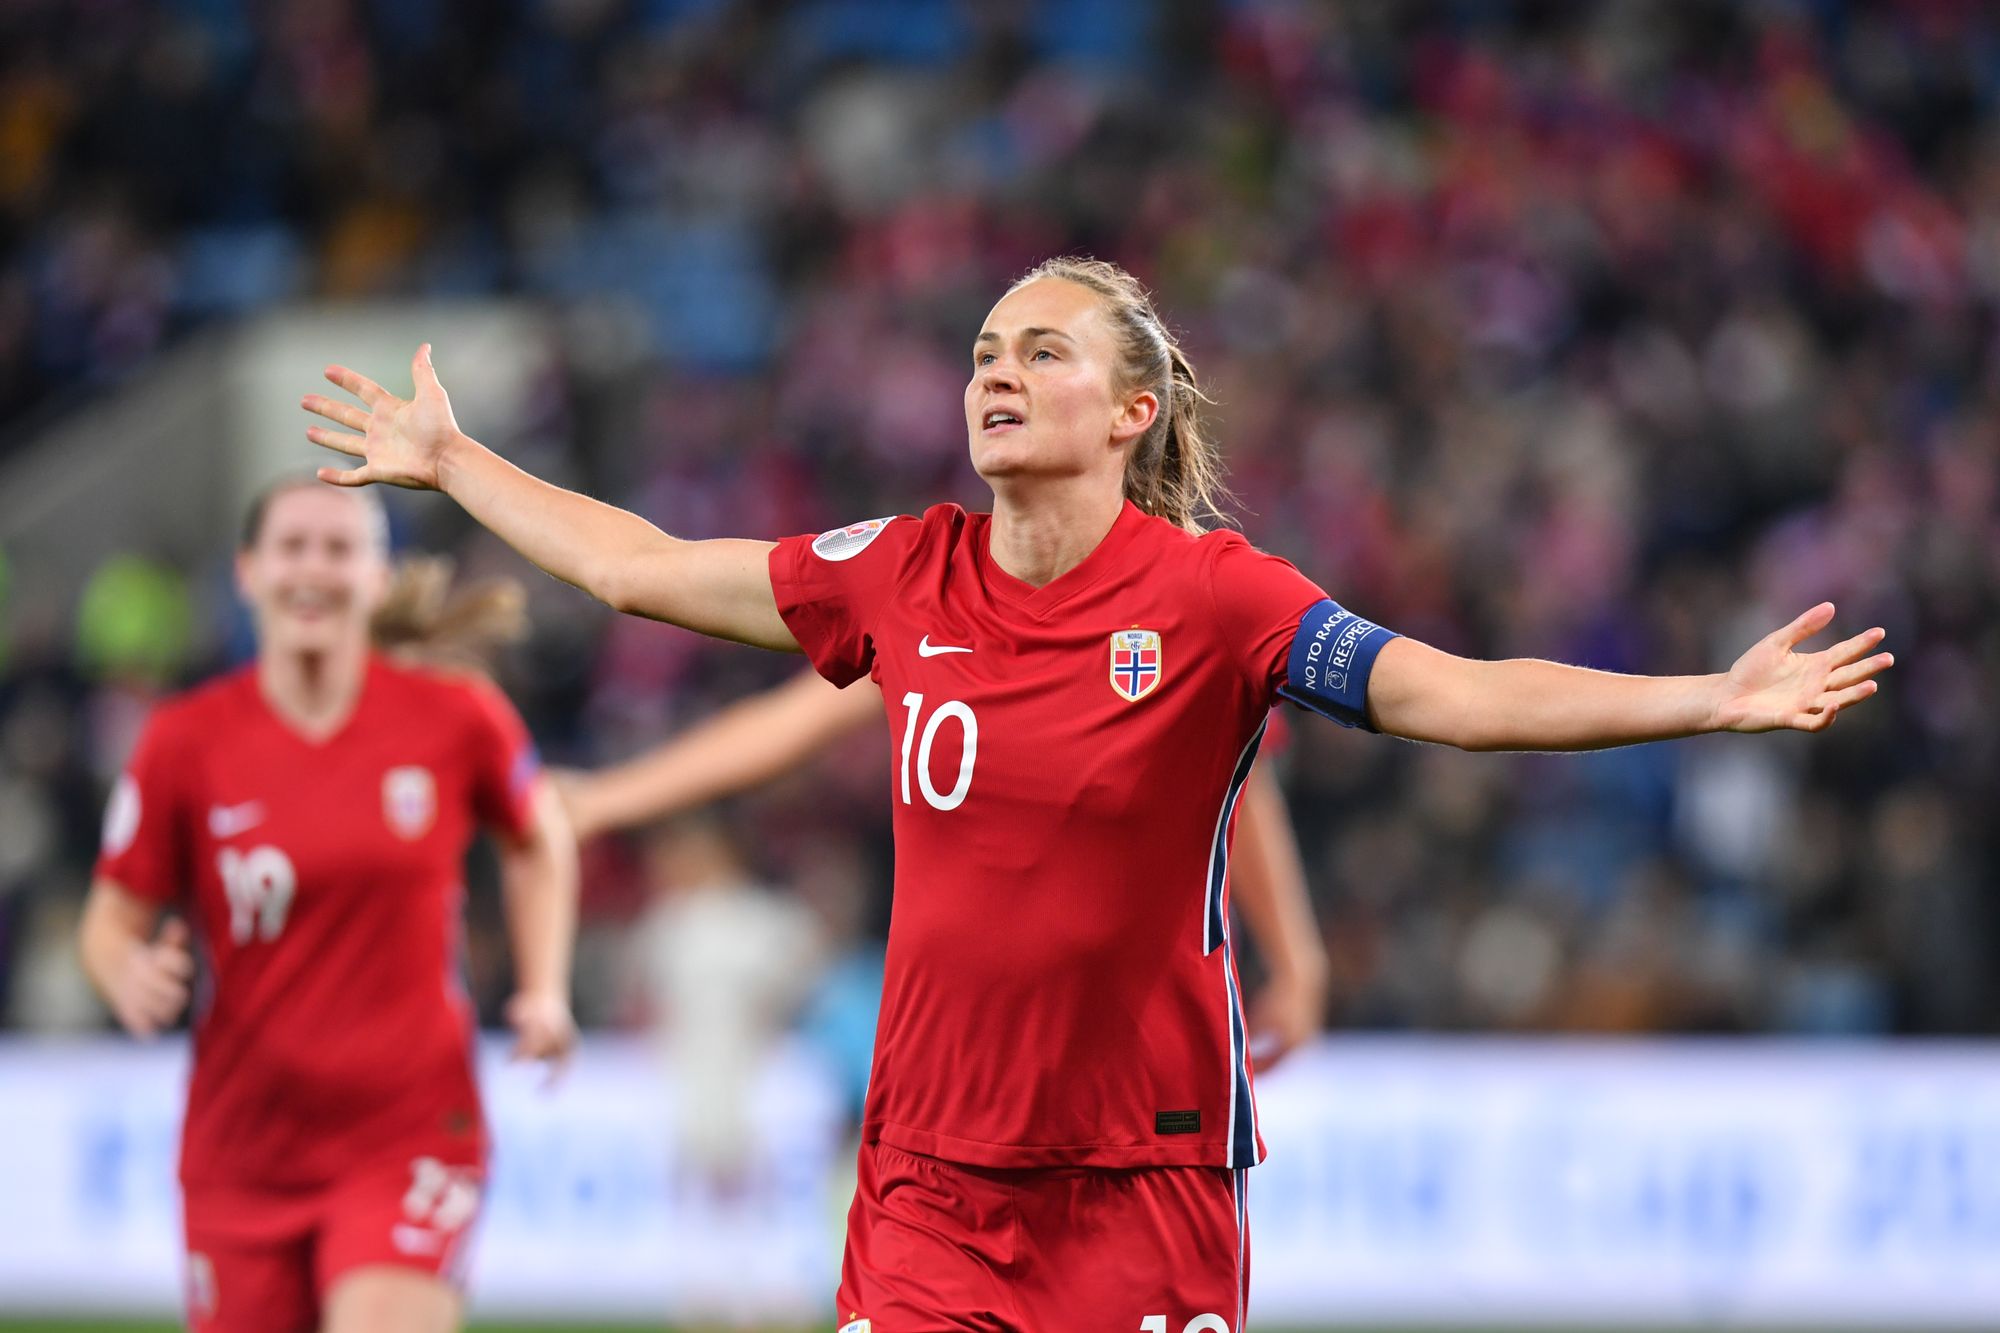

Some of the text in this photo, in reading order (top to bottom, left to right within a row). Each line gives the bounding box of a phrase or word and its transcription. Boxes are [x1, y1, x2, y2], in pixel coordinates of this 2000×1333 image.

[1305, 609, 1352, 690] NO TO RACIS
[901, 691, 978, 811] 10
[218, 846, 296, 944] 19
